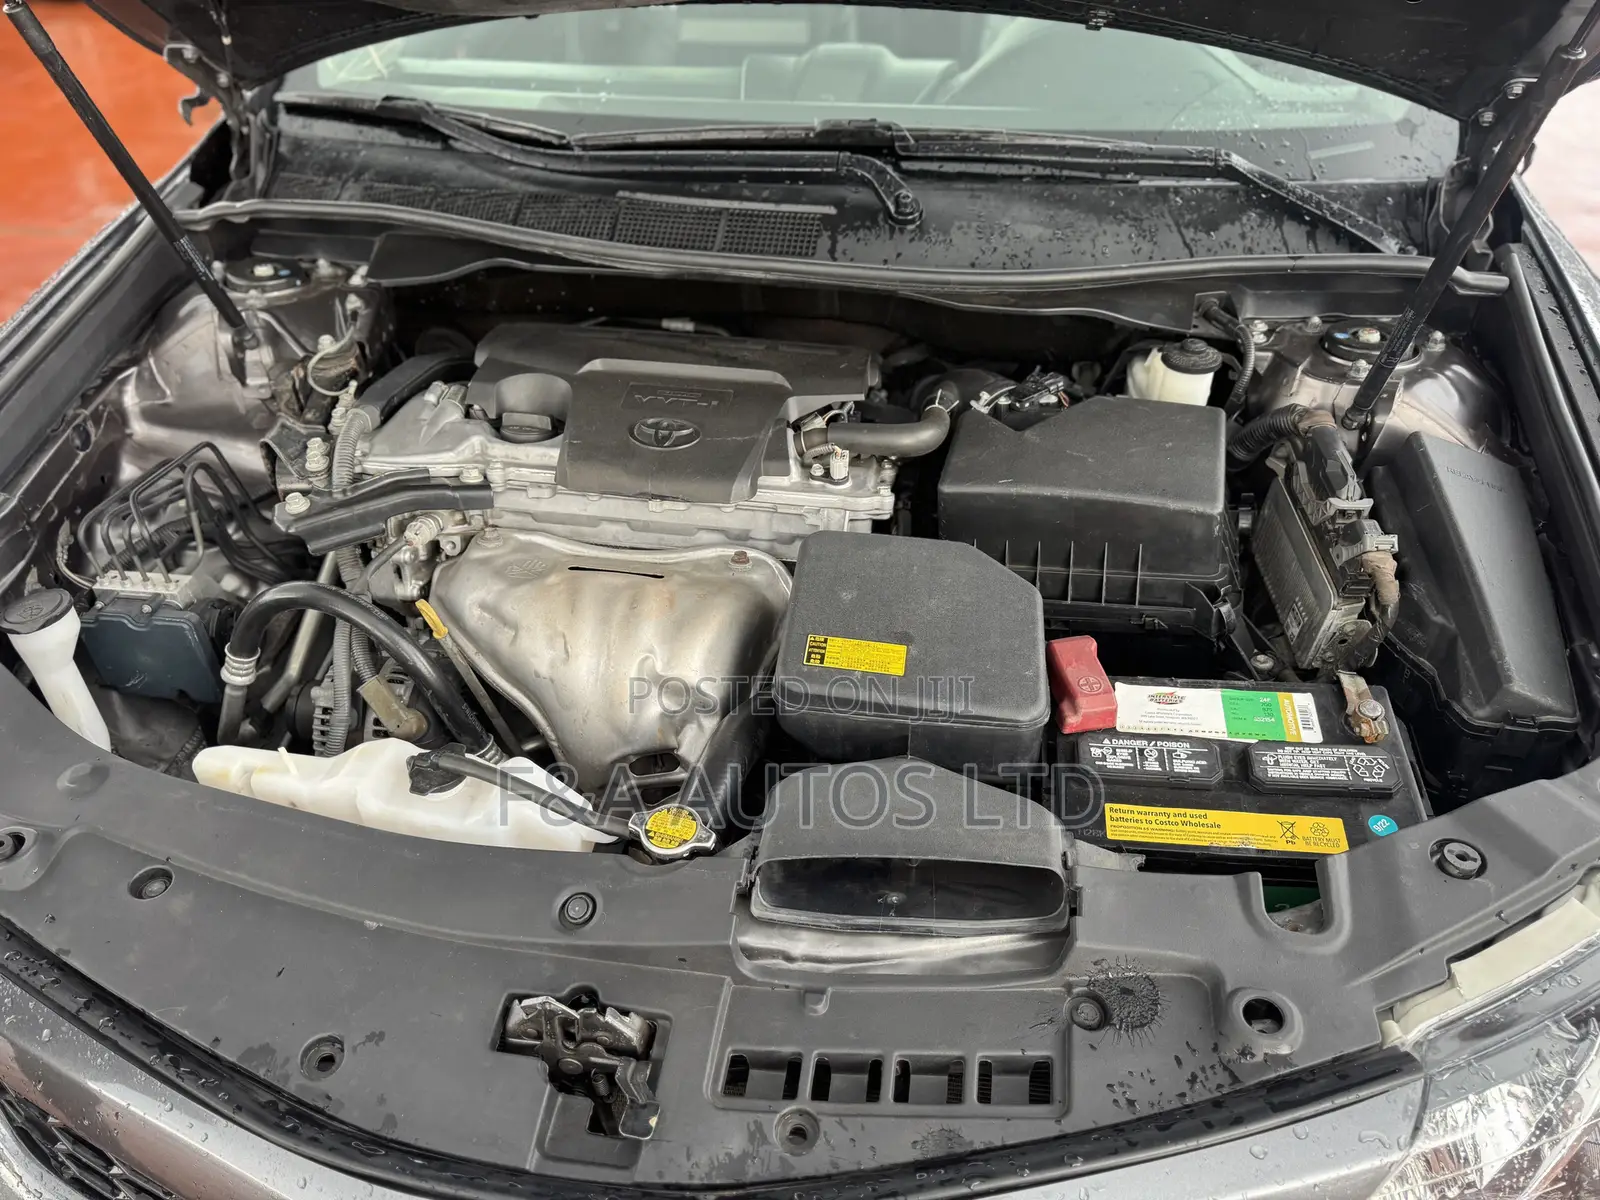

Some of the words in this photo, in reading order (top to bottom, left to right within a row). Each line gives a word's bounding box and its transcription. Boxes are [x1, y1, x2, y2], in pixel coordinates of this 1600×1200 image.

[1112, 739, 1148, 747] DANGER
[1156, 741, 1191, 749] POISON
[1109, 806, 1135, 815] Return
[1136, 810, 1171, 819] warranty
[1172, 811, 1187, 819] and
[1189, 812, 1208, 820] used
[1109, 815, 1144, 825] batteries
[1180, 820, 1221, 829] Wholesale
[1372, 818, 1391, 832] 9/22
